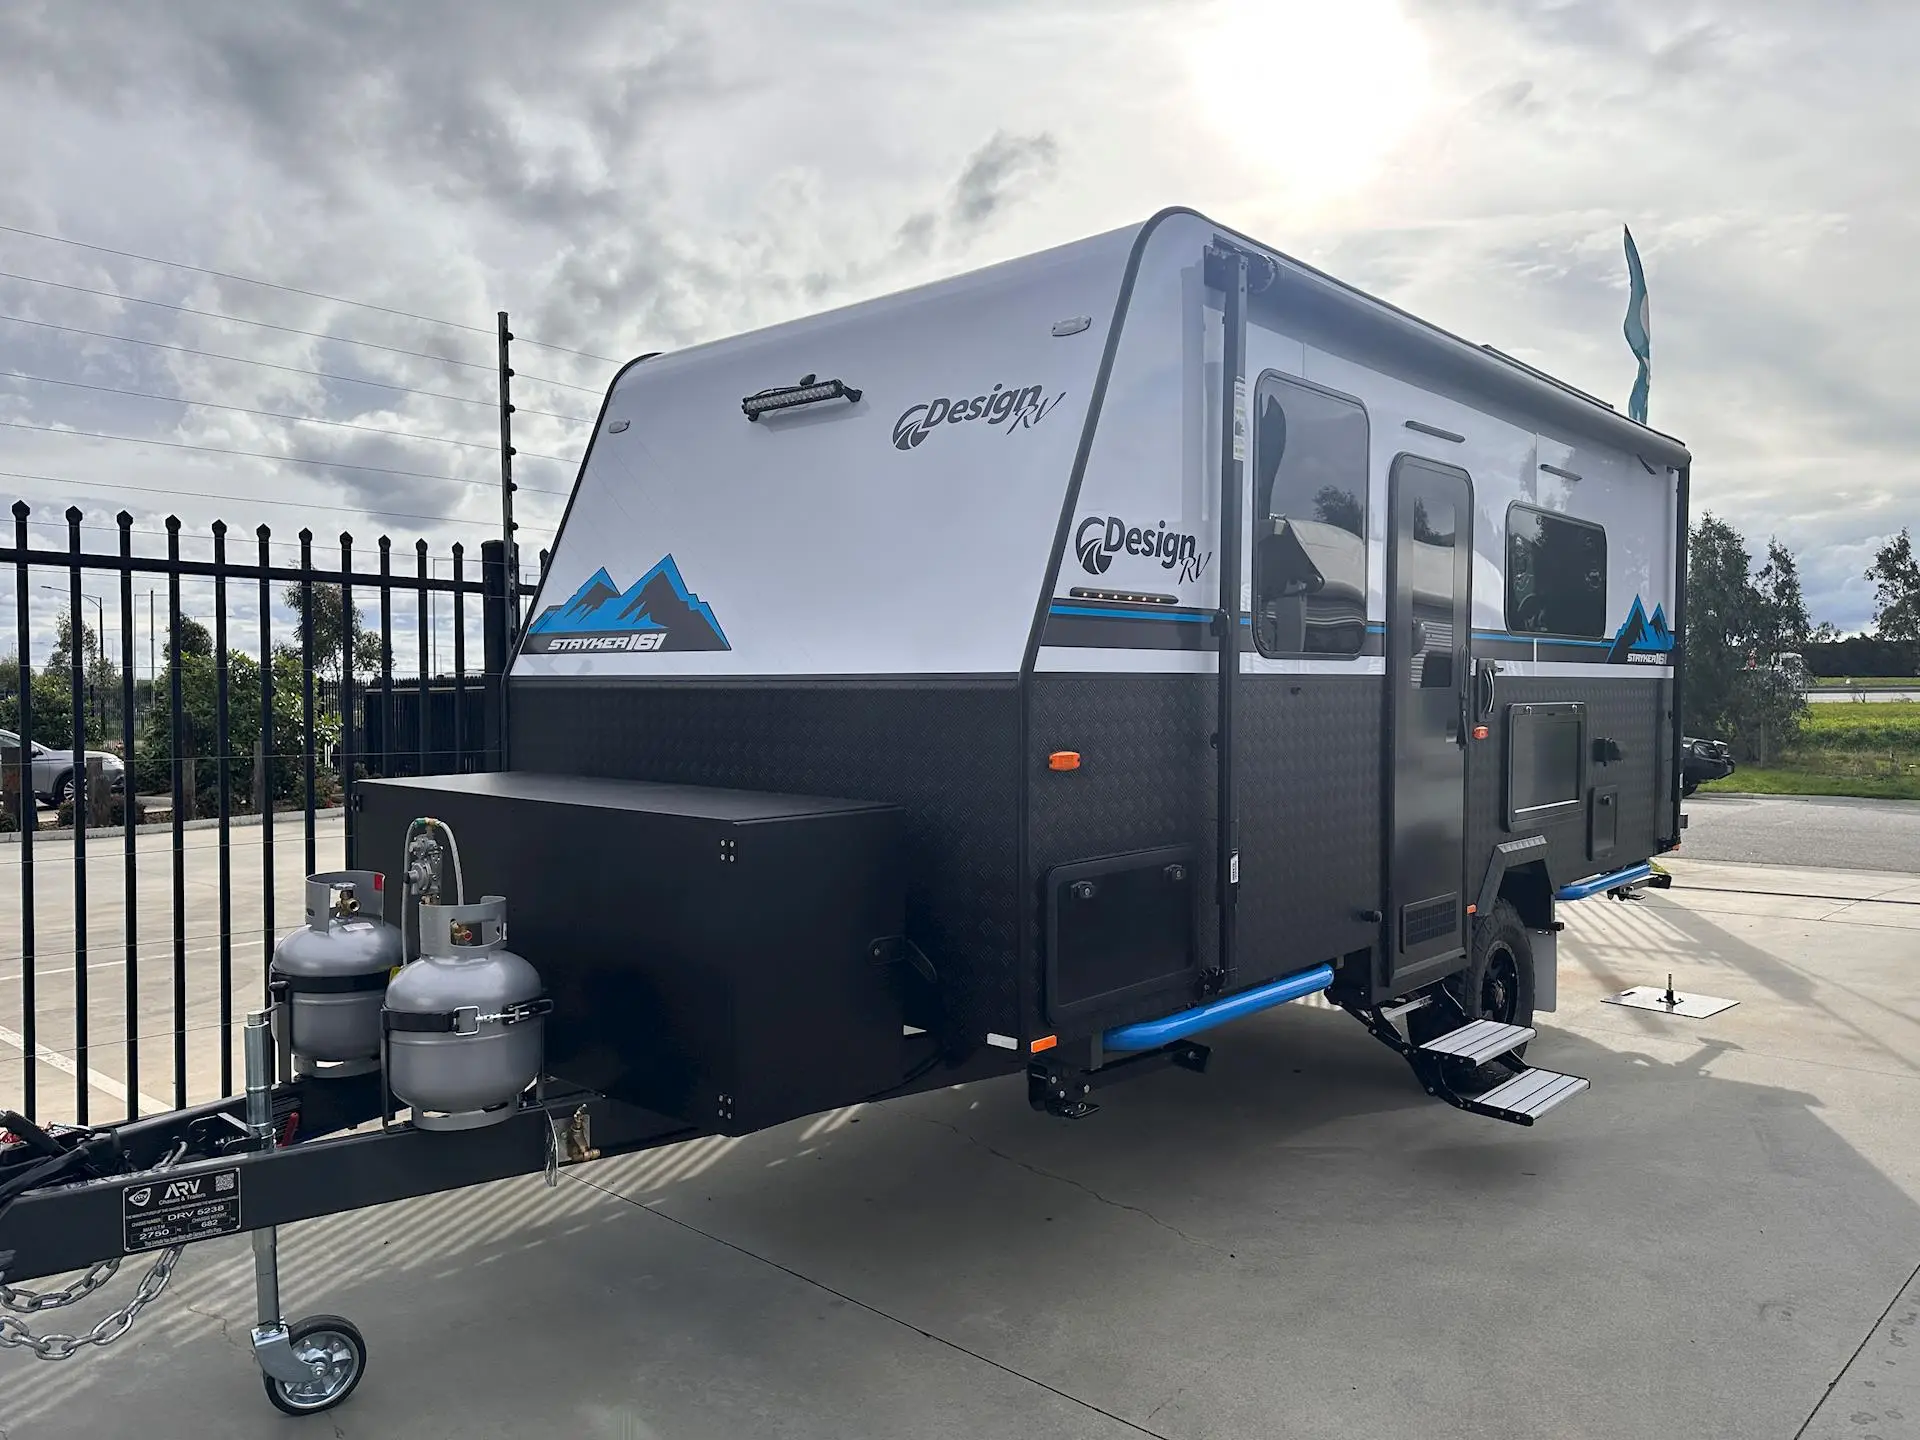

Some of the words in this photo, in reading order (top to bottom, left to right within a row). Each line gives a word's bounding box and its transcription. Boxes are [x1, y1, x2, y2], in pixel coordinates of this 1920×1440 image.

[922, 383, 1043, 428] Design
[1006, 391, 1067, 436] RV
[1103, 516, 1196, 569] Design
[1177, 551, 1212, 586] RV
[164, 1179, 200, 1199] ARV
[168, 1210, 194, 1221] DRV
[201, 1219, 218, 1228] 682
[139, 1229, 170, 1240] 2750
